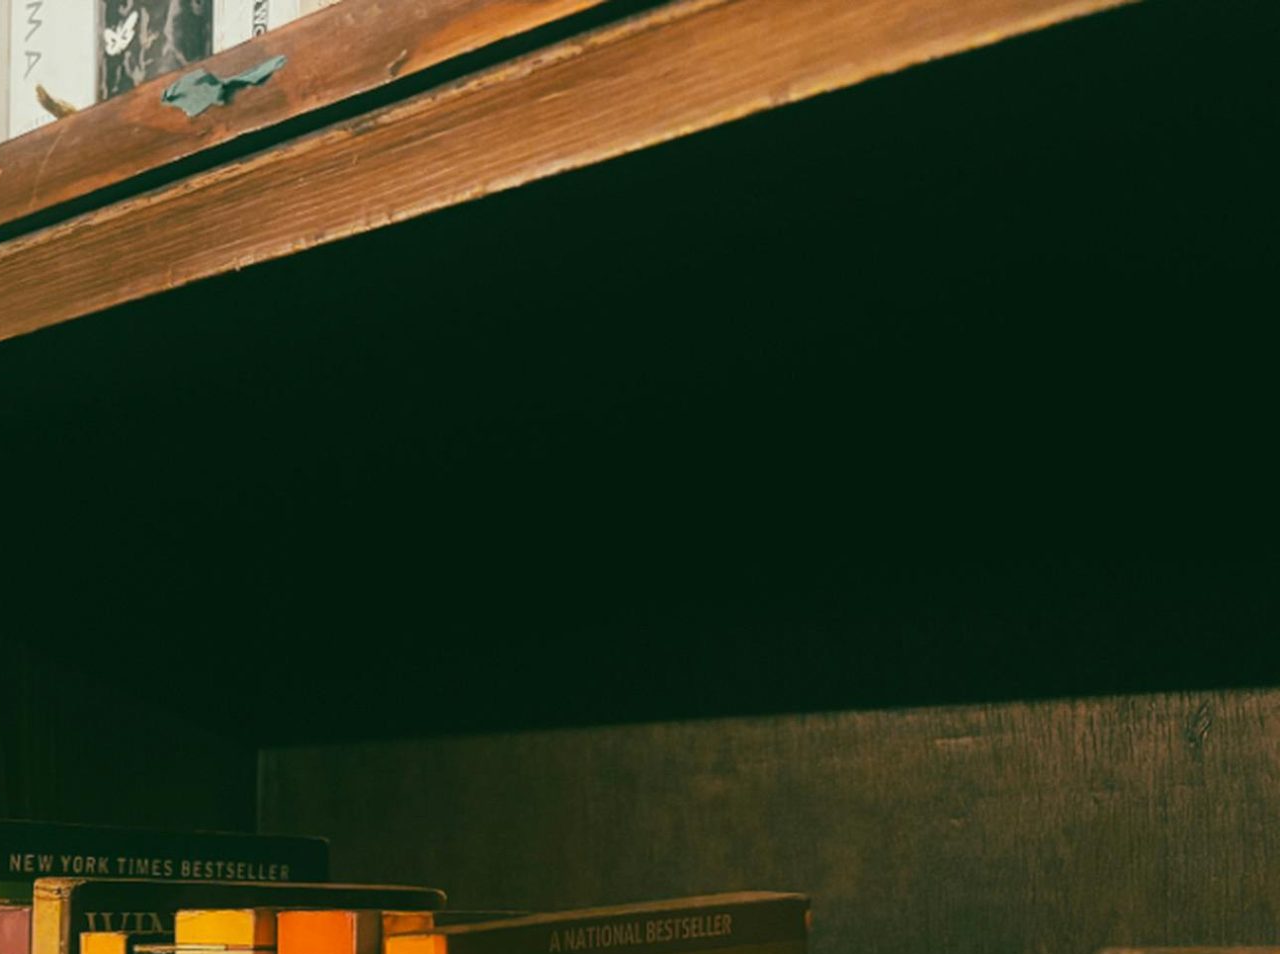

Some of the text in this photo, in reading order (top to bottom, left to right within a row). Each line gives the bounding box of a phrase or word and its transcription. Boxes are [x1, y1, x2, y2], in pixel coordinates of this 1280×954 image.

[9, 853, 54, 873] NEW
[61, 854, 110, 875] YORK
[117, 857, 173, 877] TIMES
[181, 860, 290, 881] BESTSELLER
[549, 904, 733, 953] A NATIONAL BESTSELLER
